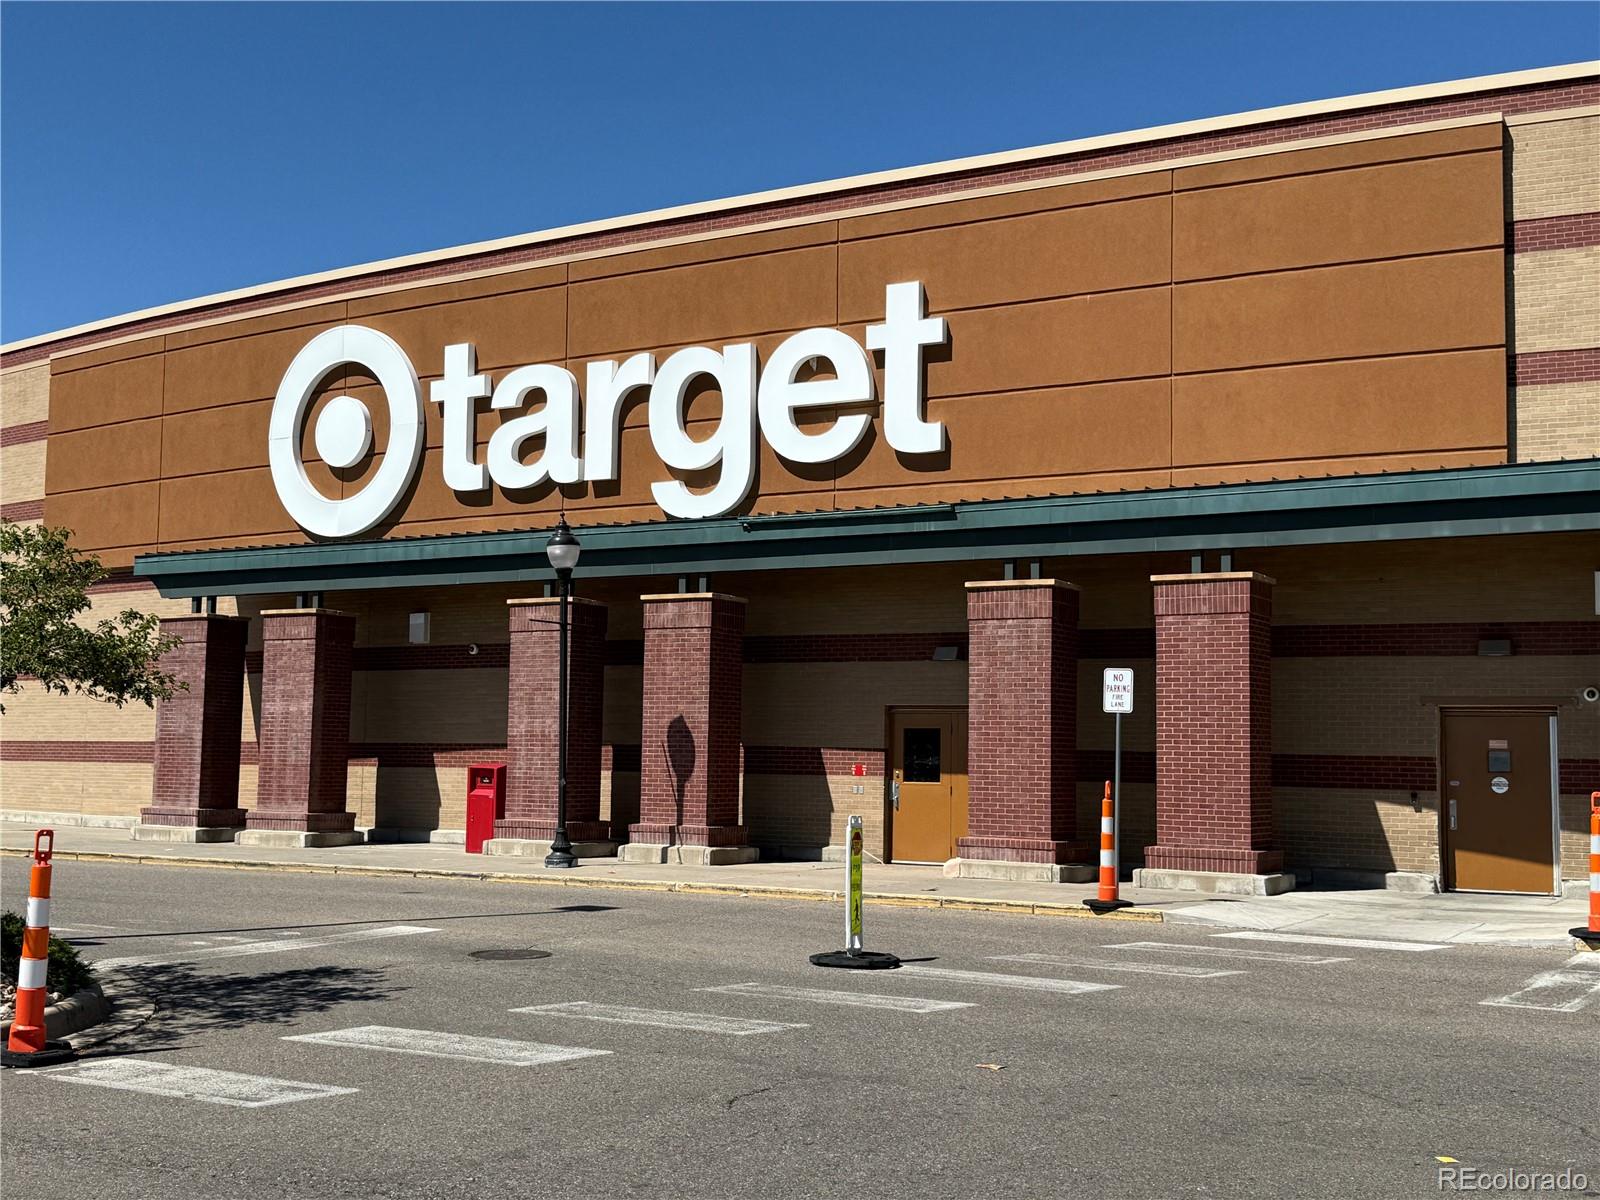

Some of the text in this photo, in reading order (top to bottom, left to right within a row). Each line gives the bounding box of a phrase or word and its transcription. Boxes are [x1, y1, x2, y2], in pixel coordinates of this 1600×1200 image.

[430, 280, 947, 518] target
[1113, 673, 1124, 682] NO
[1106, 684, 1131, 693] PARKING
